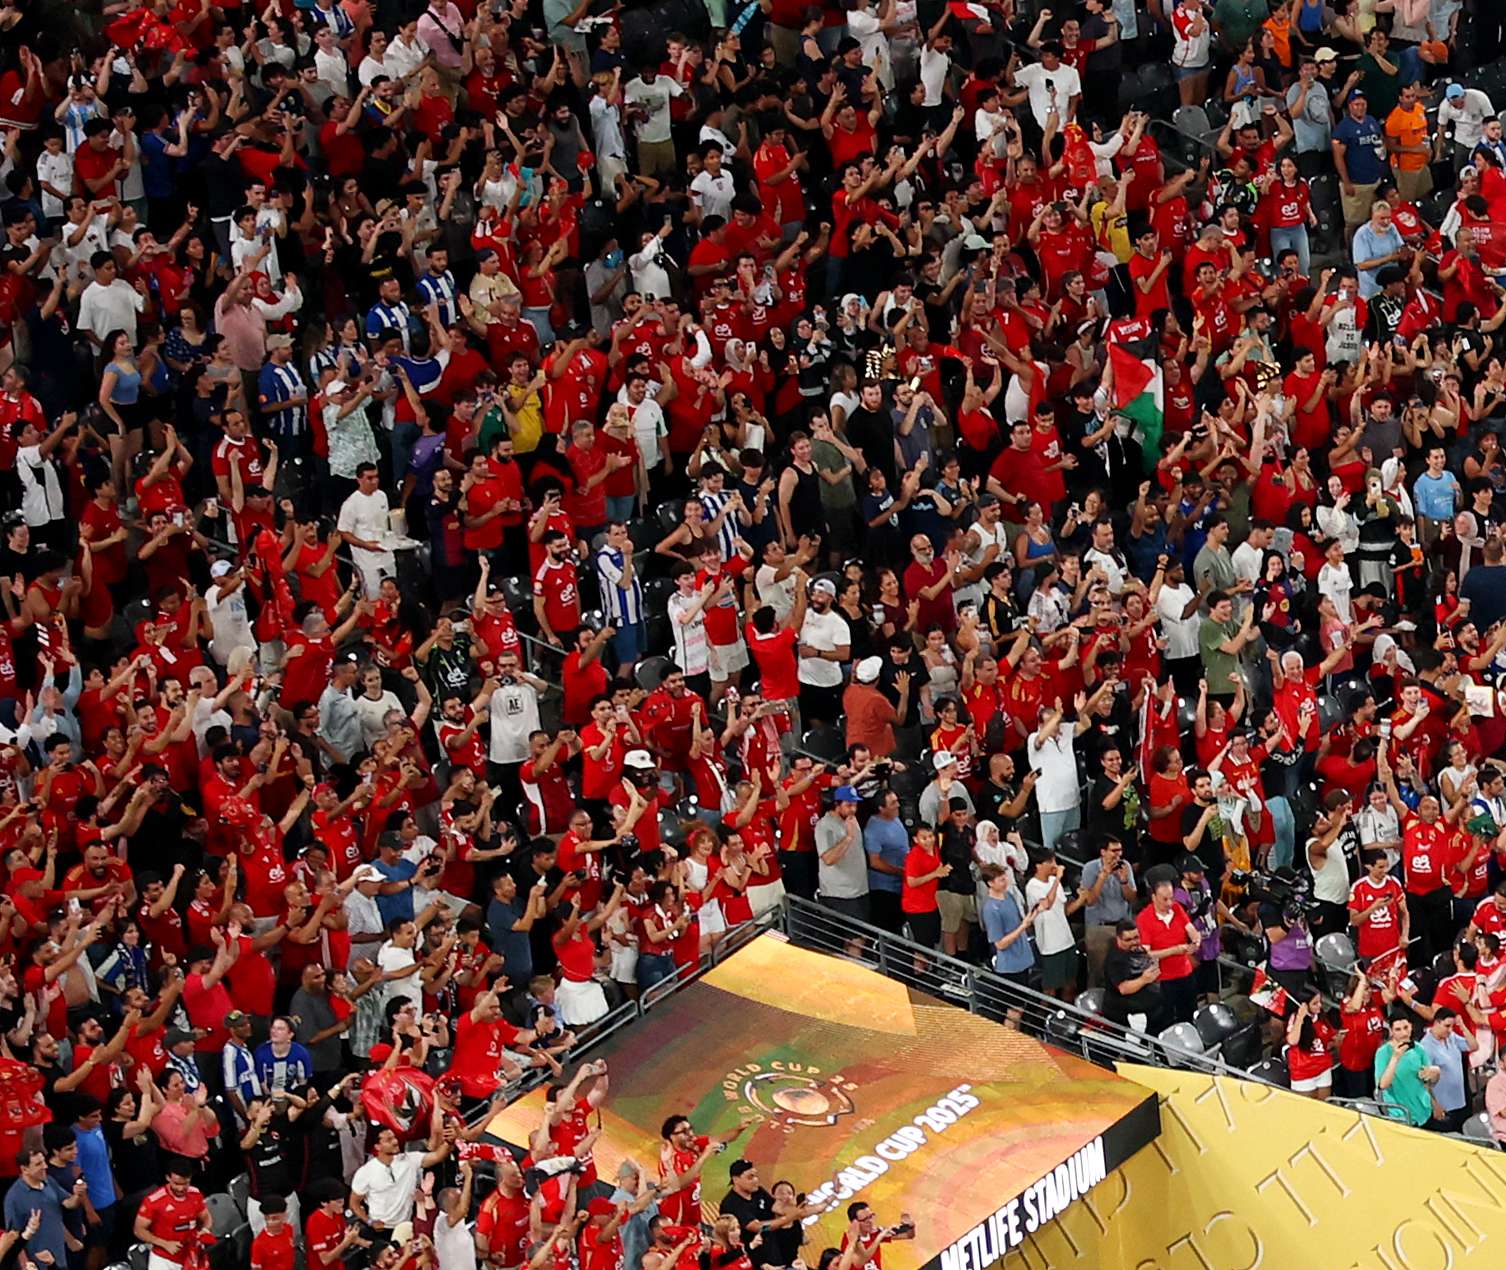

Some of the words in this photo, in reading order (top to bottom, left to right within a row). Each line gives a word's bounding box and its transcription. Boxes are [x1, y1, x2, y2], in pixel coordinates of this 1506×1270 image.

[723, 1063, 762, 1100] WORLD
[771, 1060, 820, 1075] CUP
[873, 1124, 929, 1162] CUP
[1022, 1135, 1107, 1234] STADIUM
